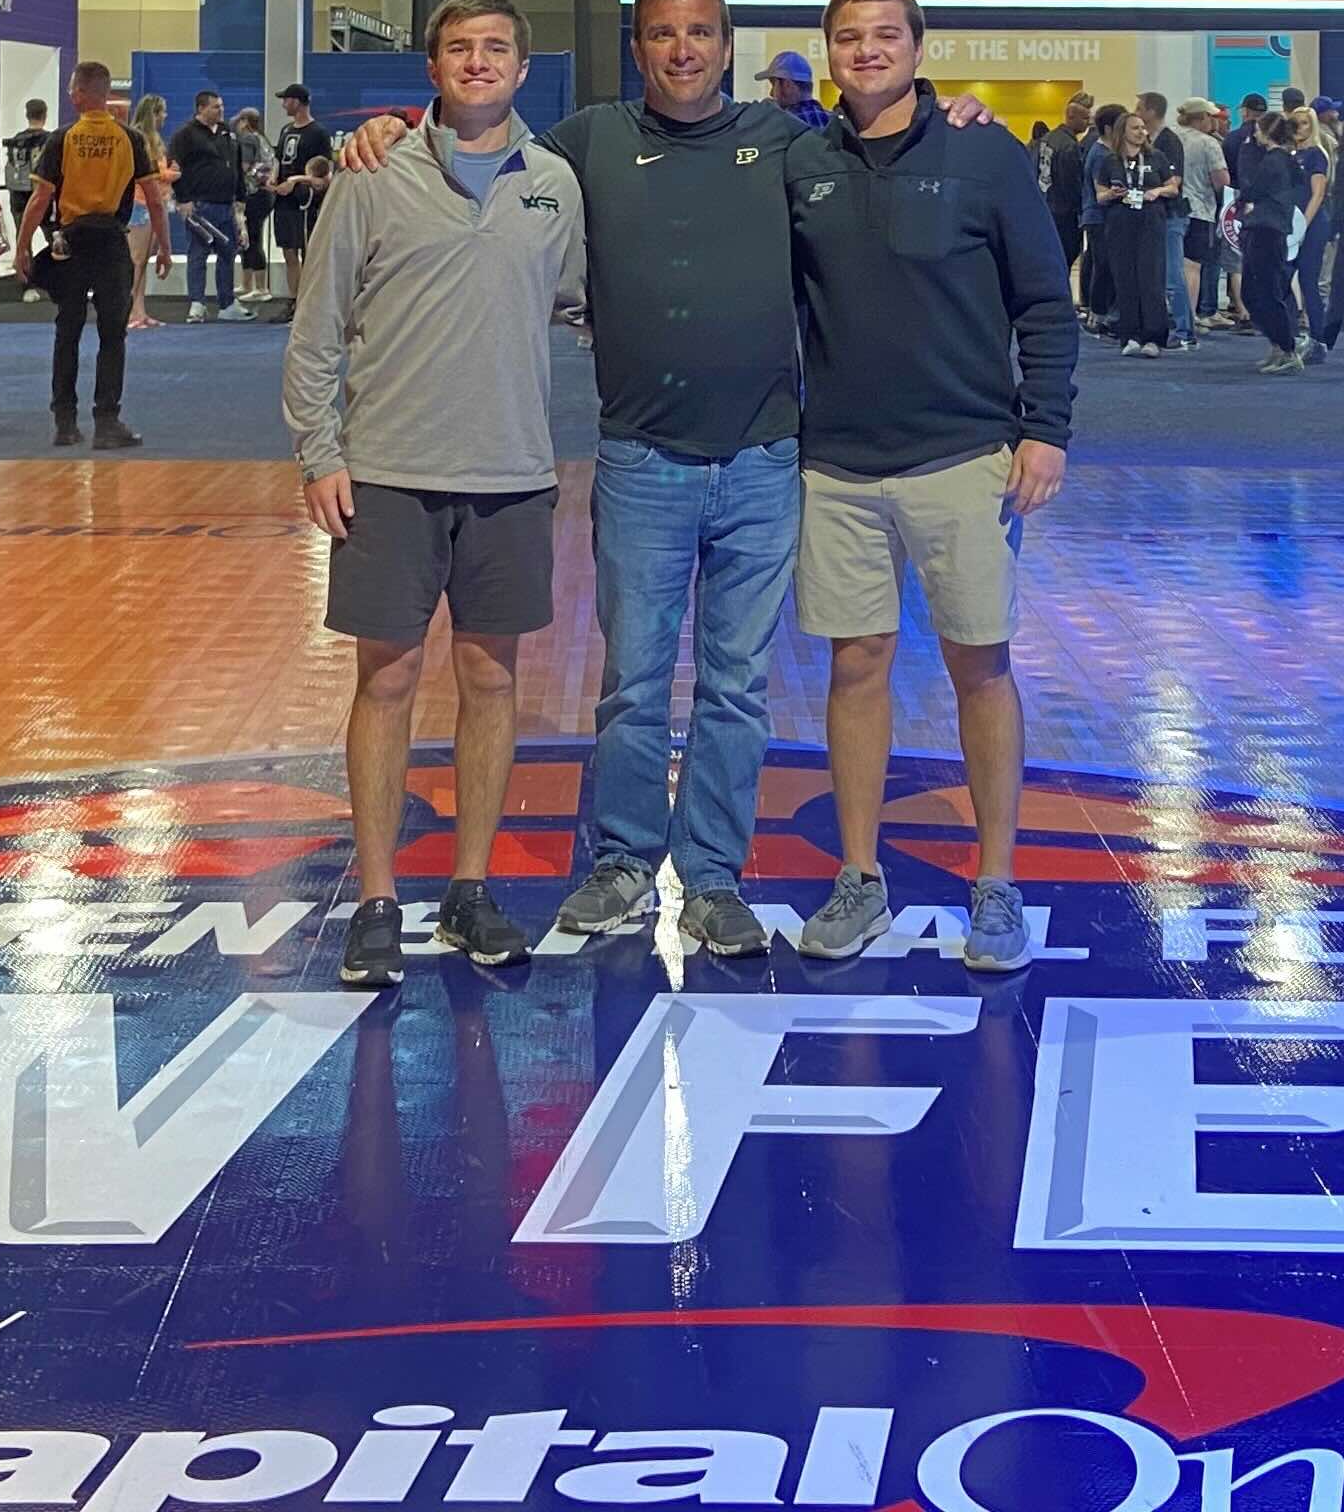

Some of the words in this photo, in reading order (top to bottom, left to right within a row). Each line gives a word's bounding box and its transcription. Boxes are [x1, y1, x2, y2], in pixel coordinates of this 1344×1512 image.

[928, 39, 956, 61] OF
[967, 39, 1009, 61] THE
[1017, 39, 1101, 62] MONTH
[71, 134, 122, 147] SECURITY
[78, 147, 115, 159] STAFF
